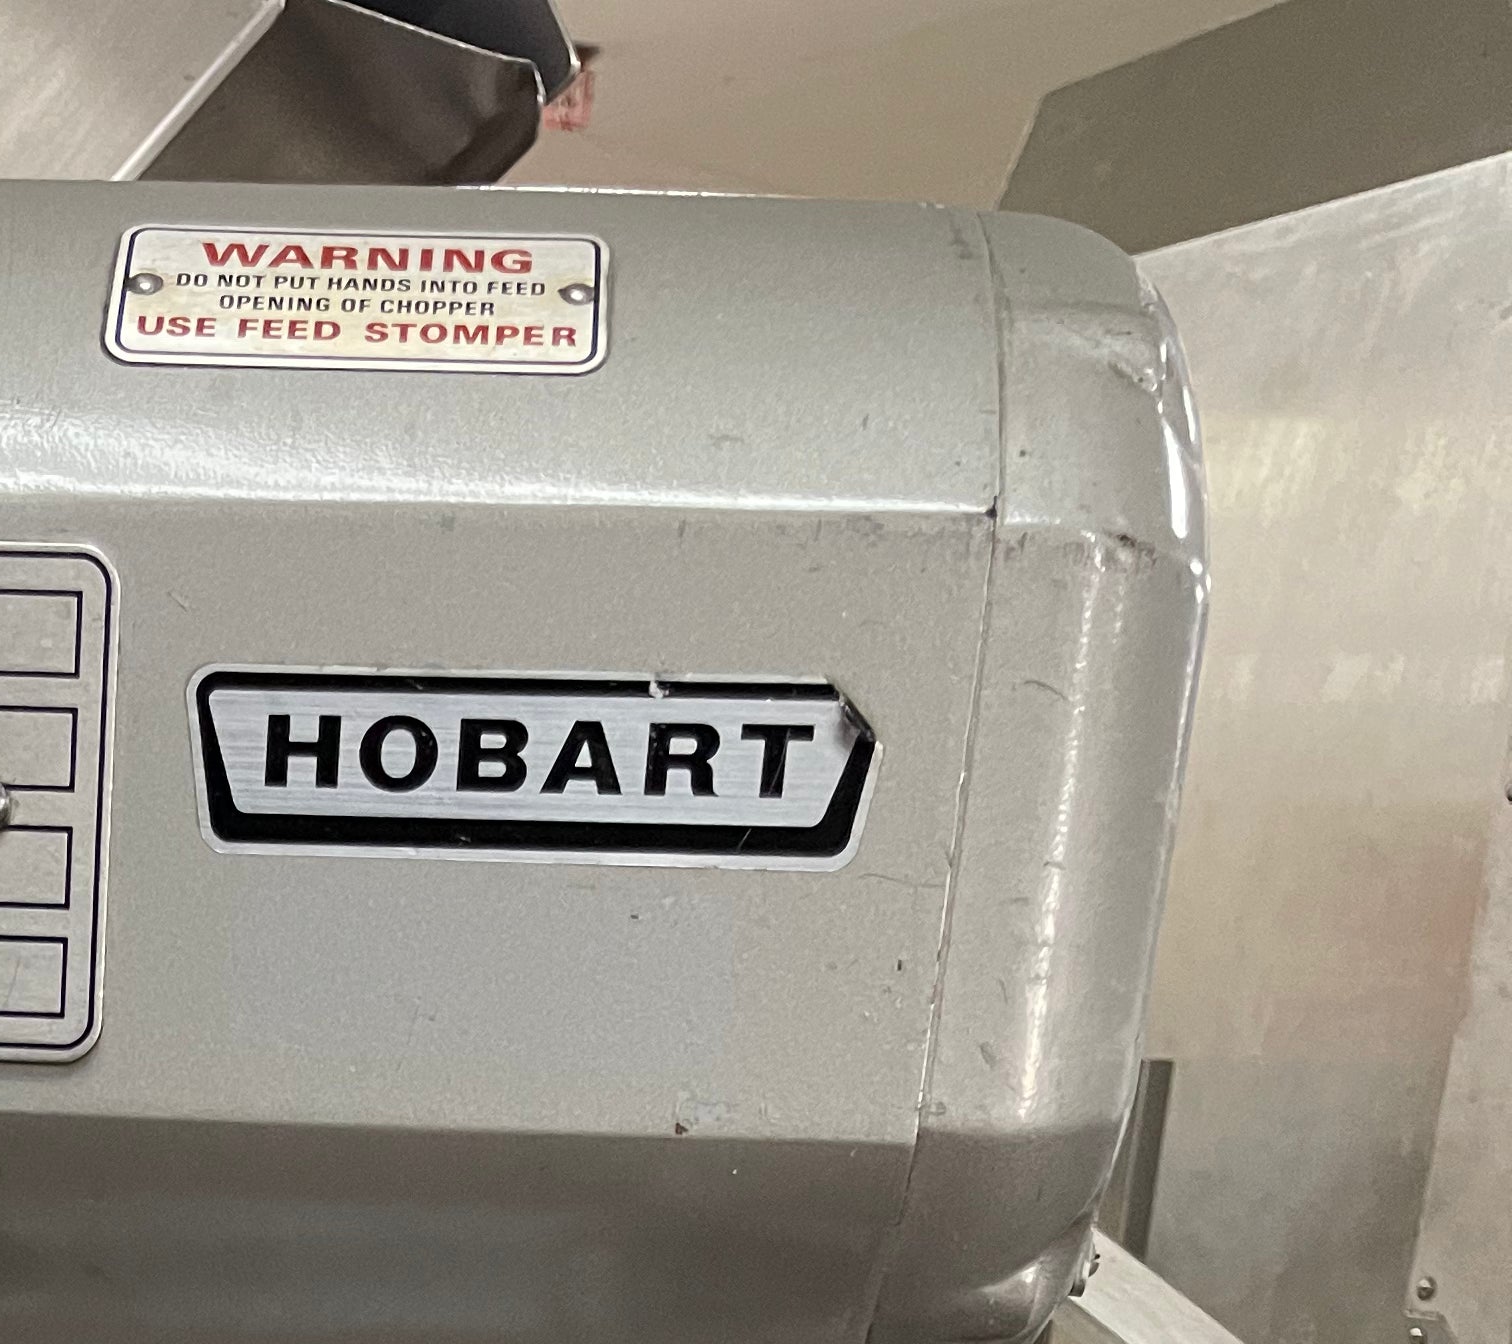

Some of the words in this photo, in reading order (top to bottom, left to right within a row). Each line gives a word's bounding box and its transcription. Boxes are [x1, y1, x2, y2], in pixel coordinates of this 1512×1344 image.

[203, 242, 533, 274] WARNING
[176, 273, 209, 287] DO
[218, 274, 265, 289] NOT
[274, 275, 319, 290] PUT
[327, 277, 411, 293] HANDS
[420, 279, 478, 295] INTO
[487, 281, 546, 297] FEED
[219, 295, 332, 312] OPENING
[341, 298, 371, 314] OF
[380, 299, 495, 317] CHOPPER
[137, 316, 217, 337] USE
[238, 319, 341, 341] FEED
[364, 322, 577, 347] STOMPER
[264, 714, 815, 799] HOBART
